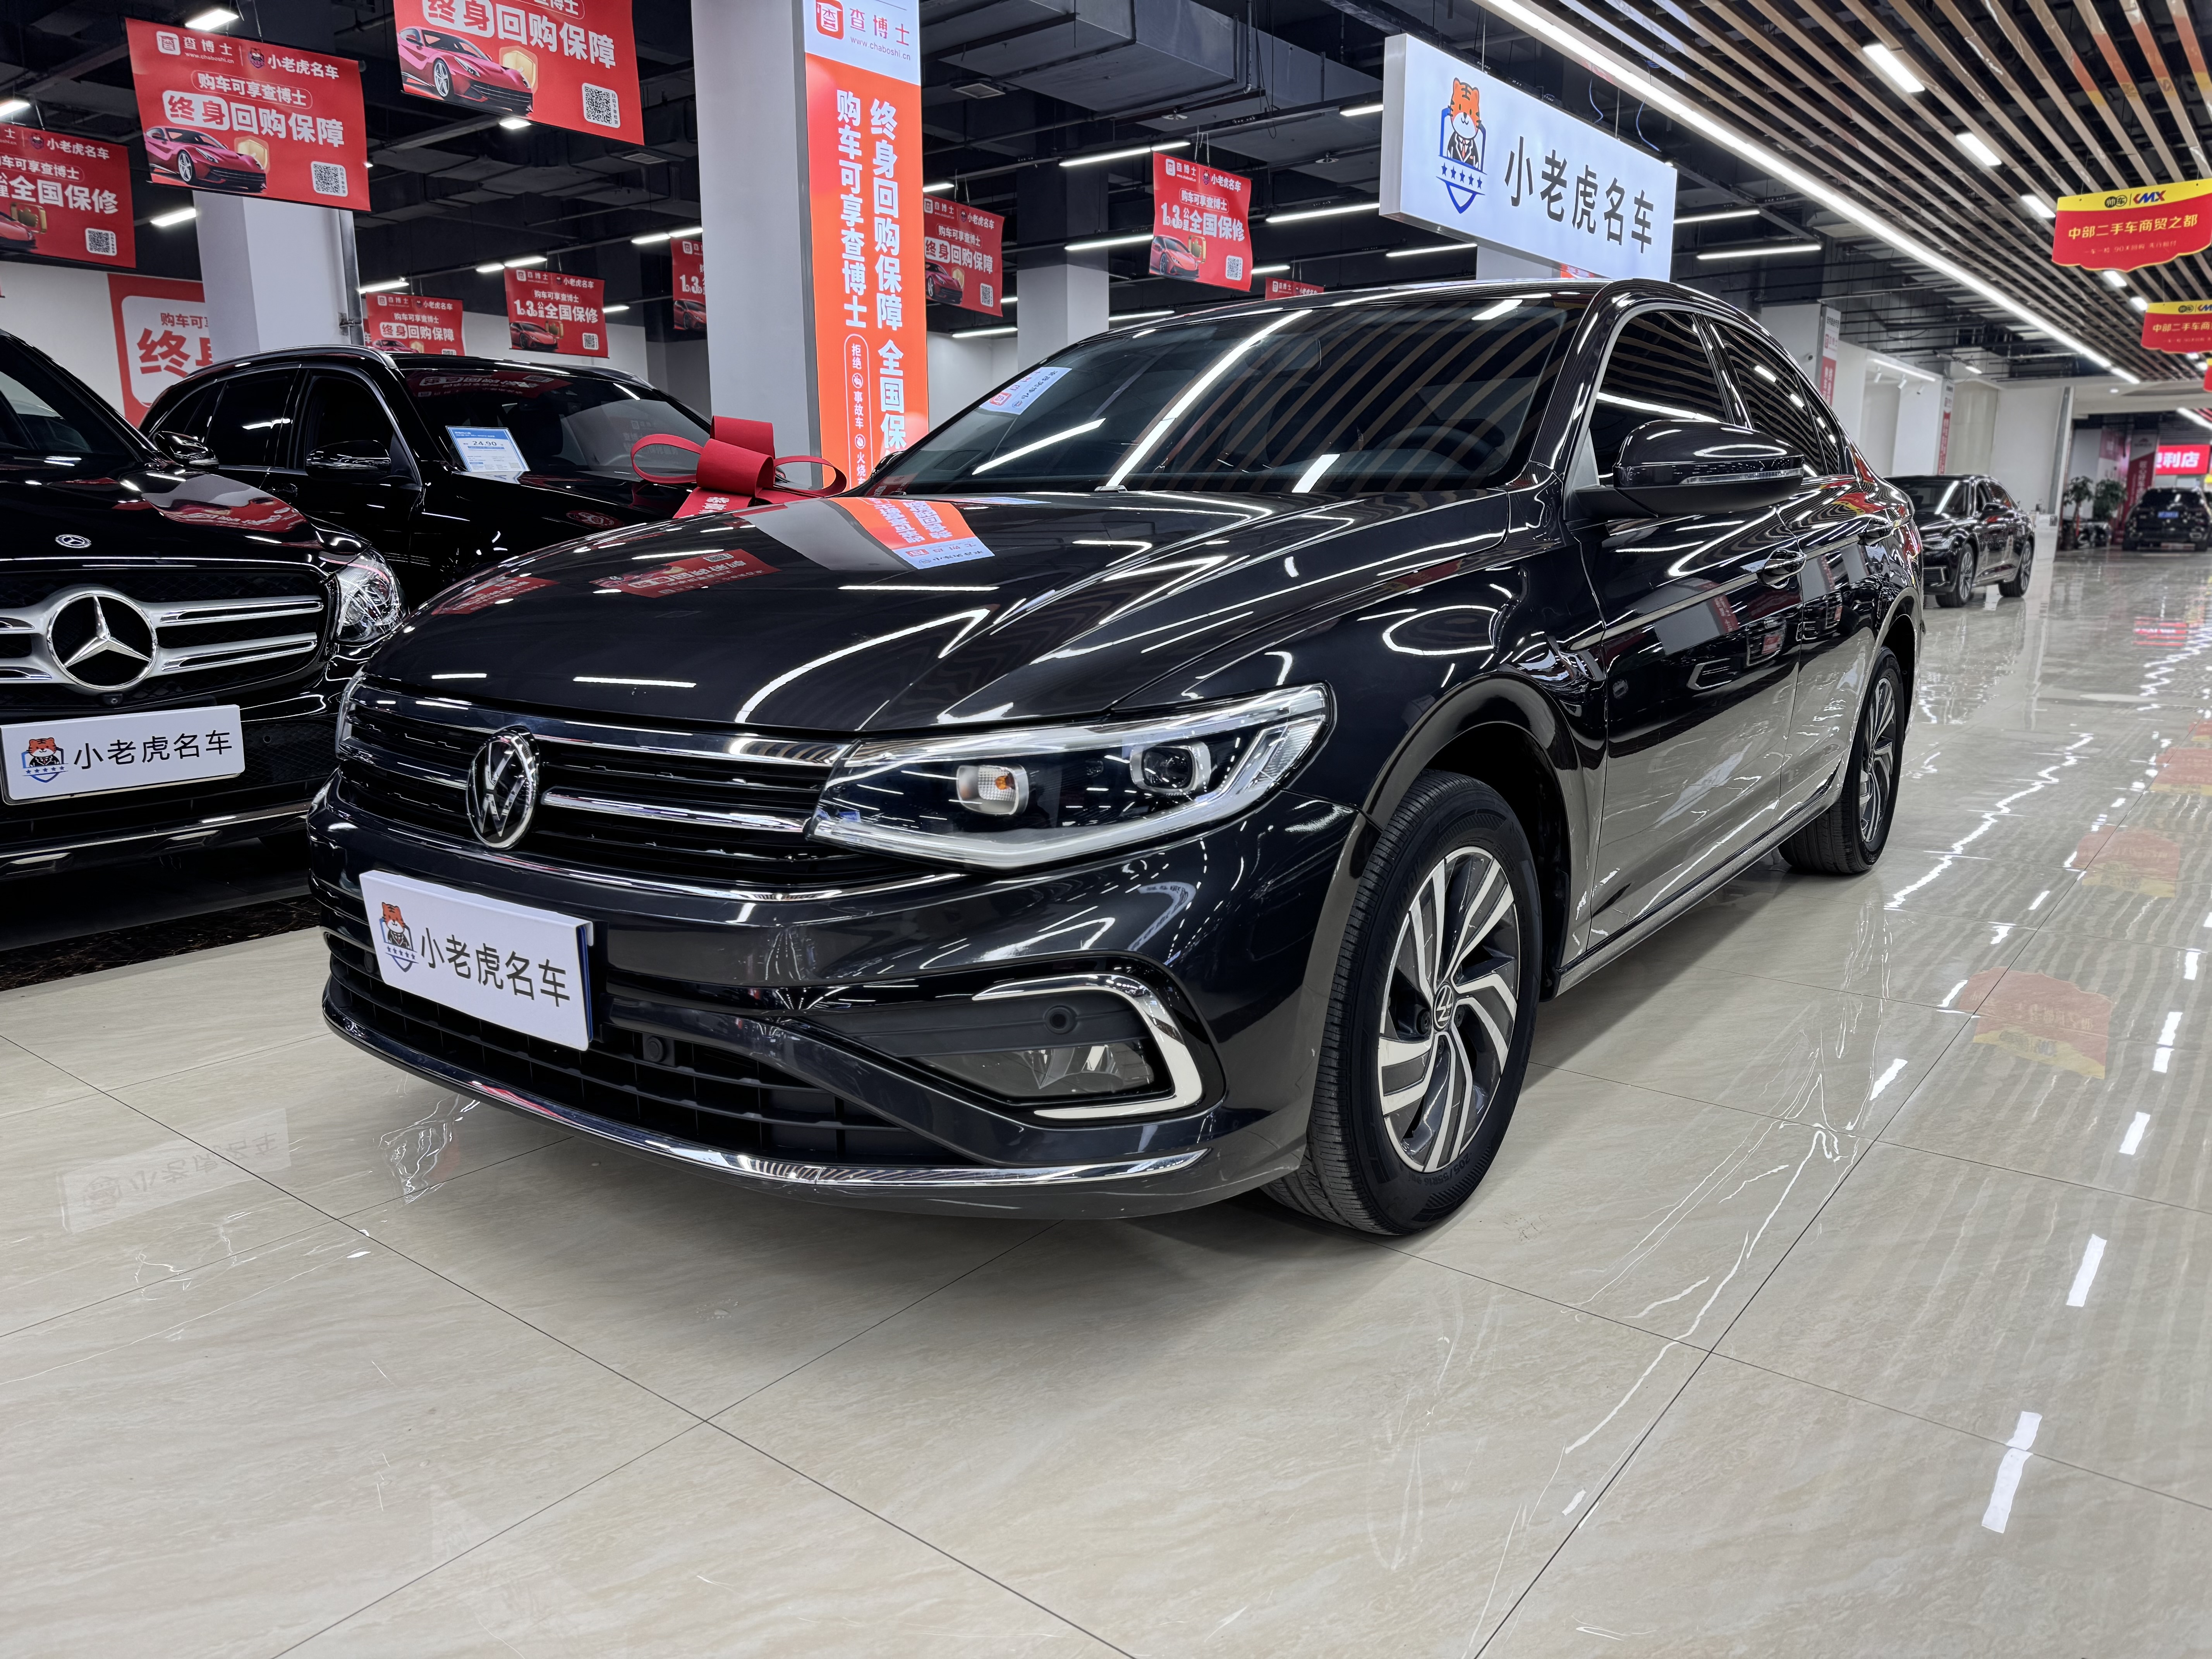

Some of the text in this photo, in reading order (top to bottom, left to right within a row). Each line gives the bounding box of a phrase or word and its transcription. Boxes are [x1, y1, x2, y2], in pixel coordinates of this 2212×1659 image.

[428, 0, 616, 69] 终身回购保障
[850, 8, 910, 46] 查博士
[183, 37, 339, 79] 查博士 小老虎名车
[850, 37, 910, 61] www.chaboshi.cn
[198, 73, 307, 106] 购车可享查博士
[168, 95, 344, 147] 终身回购保障
[47, 138, 110, 160] 小老虎名车
[0, 155, 79, 180] 车可享查博士
[1211, 173, 1242, 192] 小老虎名车
[1504, 136, 1654, 254] 小老虎名车
[836, 89, 867, 329] 购车可享查博士
[1181, 190, 1228, 211] 购车可享查博士
[870, 98, 903, 331] 终身回购保障
[968, 213, 994, 229] 小老虎名车
[2068, 214, 2198, 240] 中部二手车商贸之都
[939, 225, 981, 247] 购车可享查博士
[926, 239, 993, 274] 终身回购保障
[563, 277, 594, 289] 小老虎名车
[423, 301, 453, 310] 小老虎名车
[534, 290, 579, 303] 购车可享查博士
[161, 313, 209, 329] 购车可
[394, 313, 440, 324] 购车可享查博士
[2152, 322, 2212, 333] 中部二手车商
[382, 325, 455, 342] 终身回购保障
[851, 343, 862, 369] 拒绝
[854, 391, 864, 429] 事故车
[878, 339, 907, 456] 全国保
[73, 729, 232, 769] 小老虎名车
[421, 927, 570, 1007] 小老虎名车
